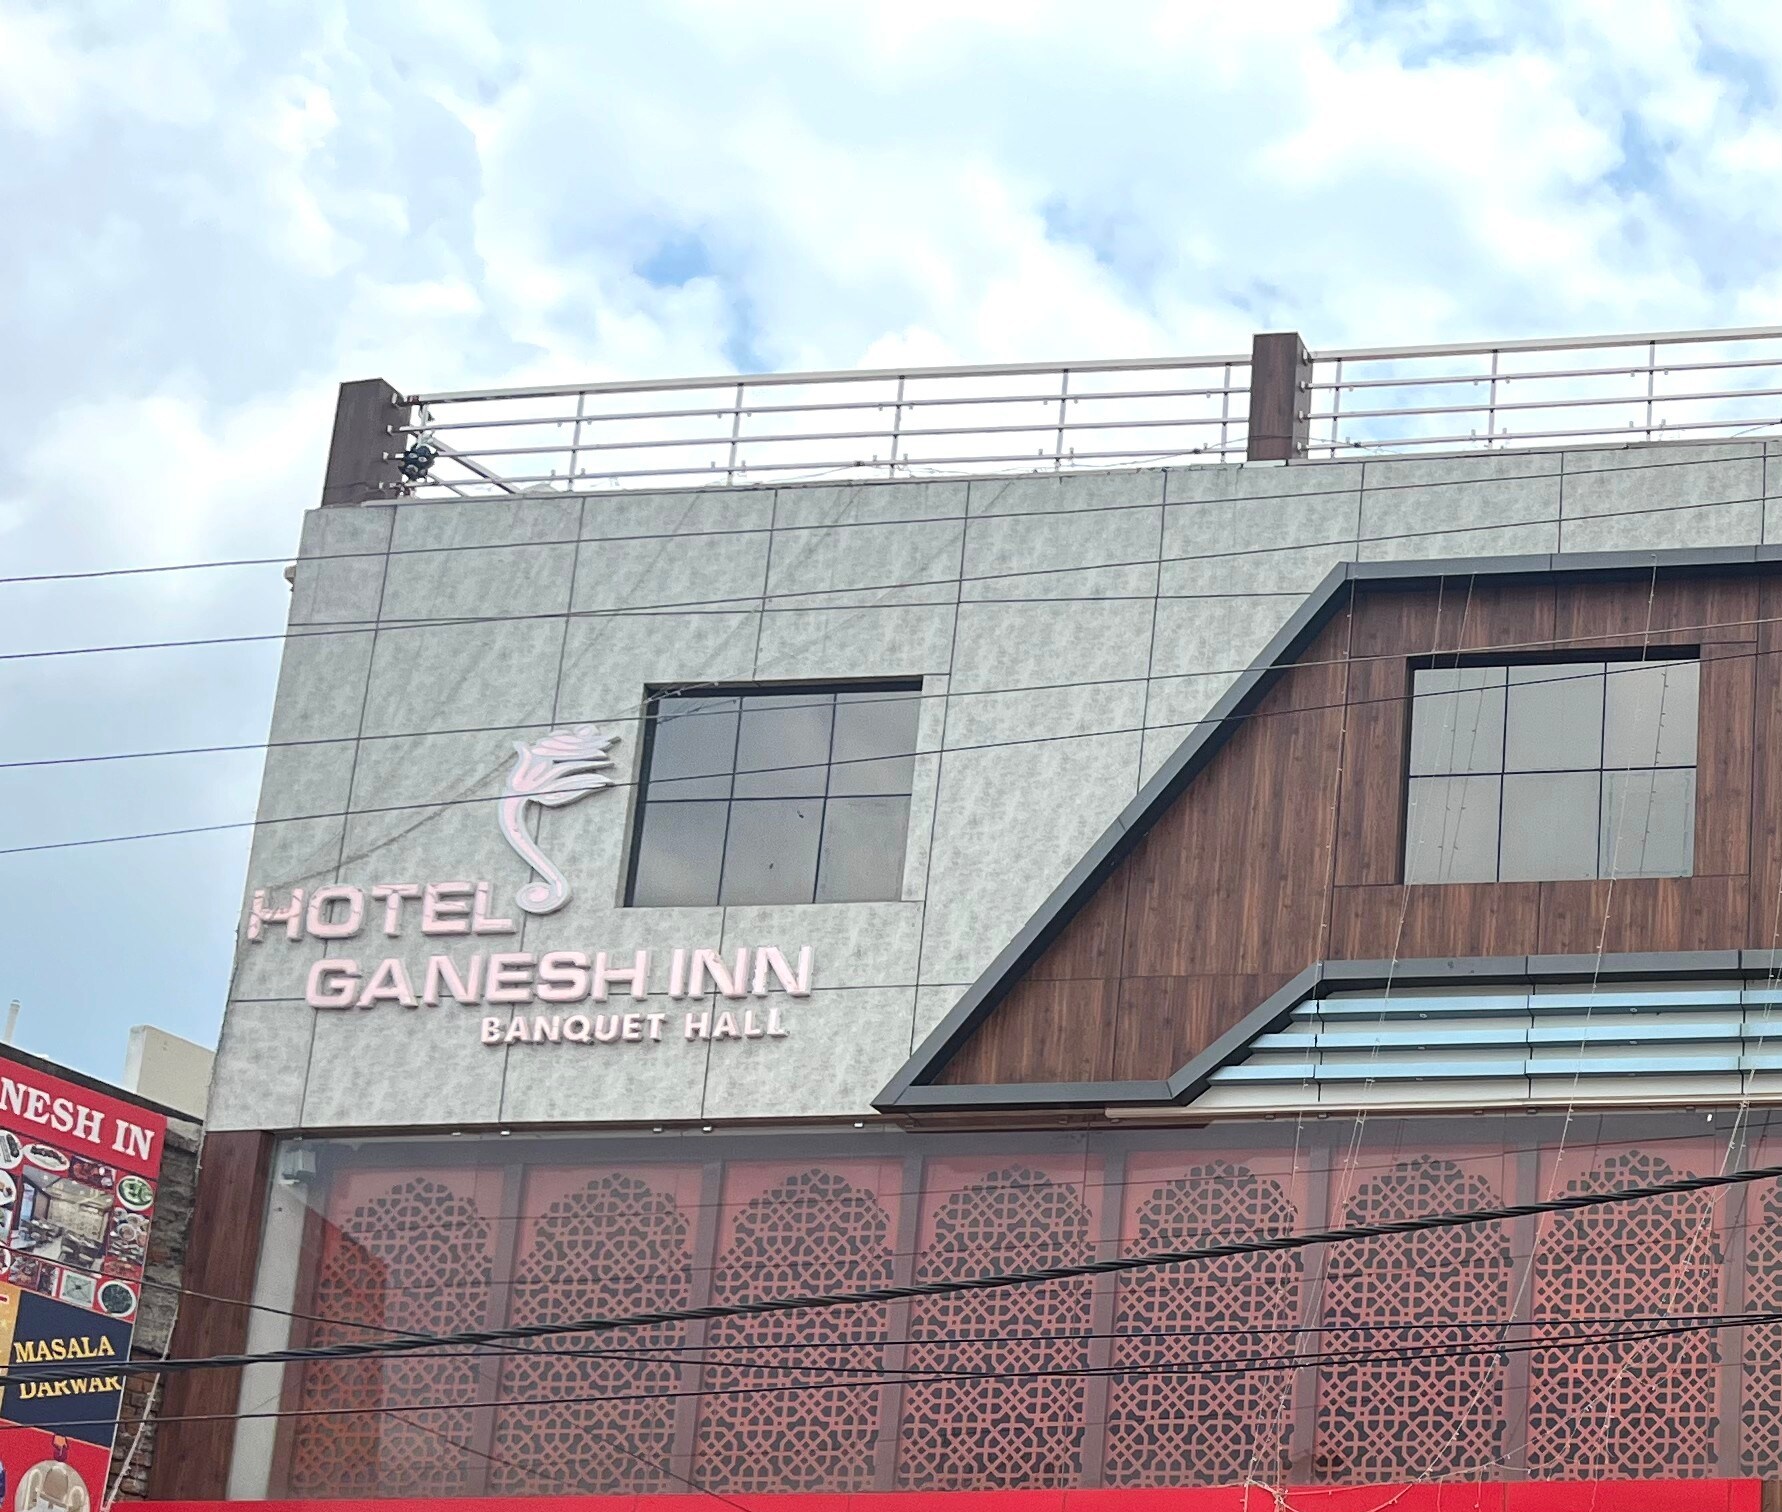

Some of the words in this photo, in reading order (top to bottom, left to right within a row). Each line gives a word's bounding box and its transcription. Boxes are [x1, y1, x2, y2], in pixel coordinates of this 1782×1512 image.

[247, 881, 517, 941] HOTEL
[305, 949, 652, 1010] GANESH
[669, 945, 813, 1001] INN
[480, 1011, 667, 1045] BANQUET
[684, 1007, 789, 1040] HALL
[0, 1077, 105, 1144] NESH
[112, 1118, 155, 1161] IN
[13, 1335, 116, 1363] MASALA
